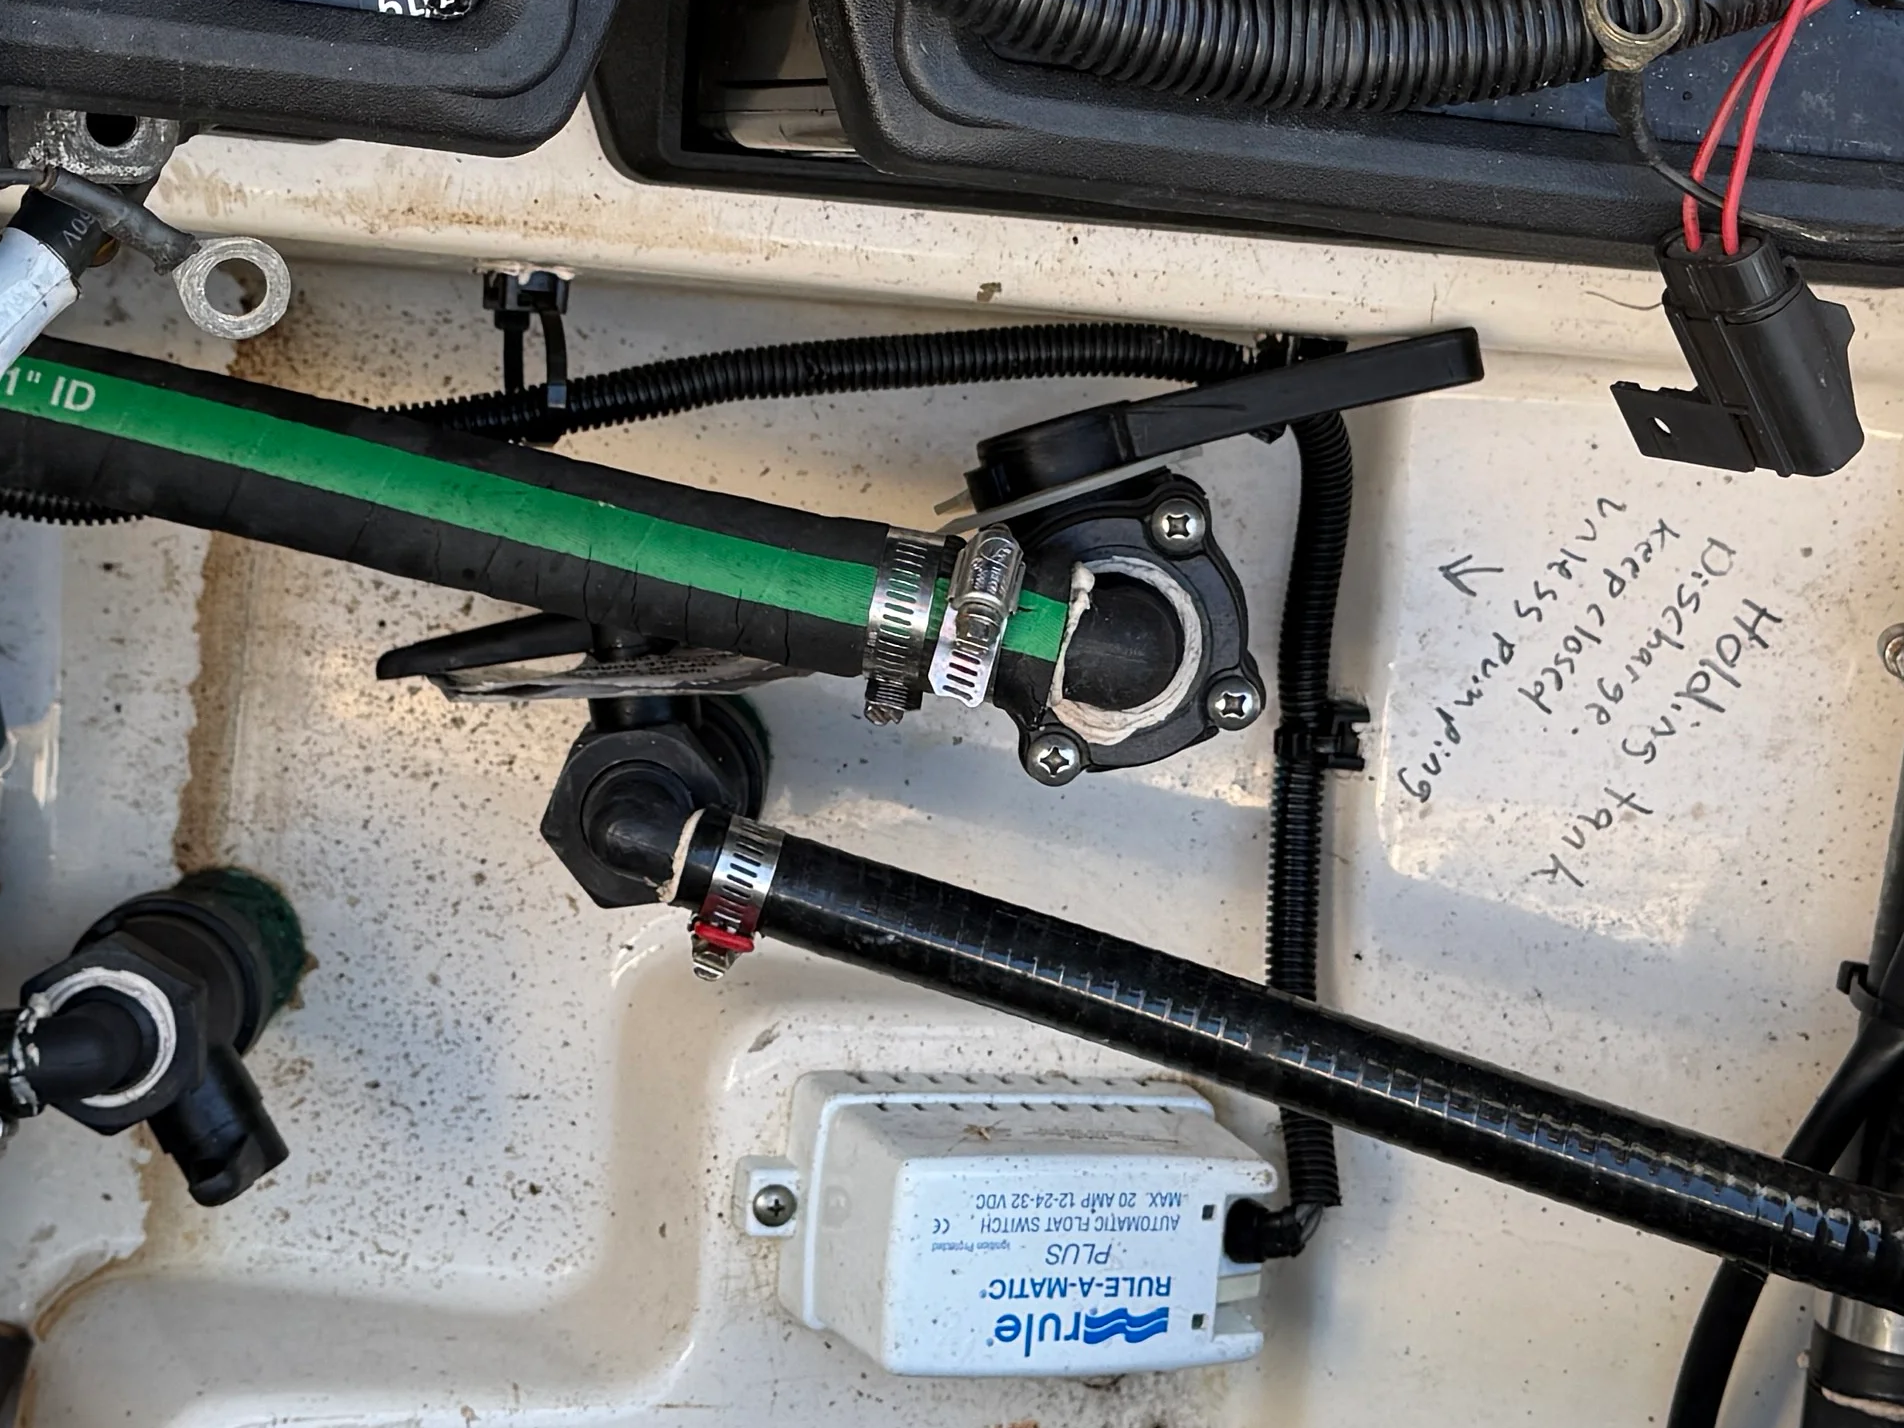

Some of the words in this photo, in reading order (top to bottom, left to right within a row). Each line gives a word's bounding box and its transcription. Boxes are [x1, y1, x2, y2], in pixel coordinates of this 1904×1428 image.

[51, 377, 96, 413] ID
[1515, 602, 1607, 719] closed
[1621, 597, 1784, 768] Holding
[1529, 787, 1656, 889] tank
[975, 1192, 1007, 1211] VDC
[1011, 1192, 1075, 1209] 12-24-32
[1080, 1192, 1114, 1209] AMP
[1118, 1191, 1137, 1208] 20
[1146, 1191, 1183, 1208] MAX.
[980, 1215, 1041, 1235] SWITCH
[1043, 1215, 1091, 1234] FLOAT
[1092, 1214, 1182, 1233] AUTOMATIC
[1045, 1243, 1113, 1266] PLUS
[987, 1275, 1172, 1300] RULE-A-MATIC
[994, 1311, 1082, 1358] rule
